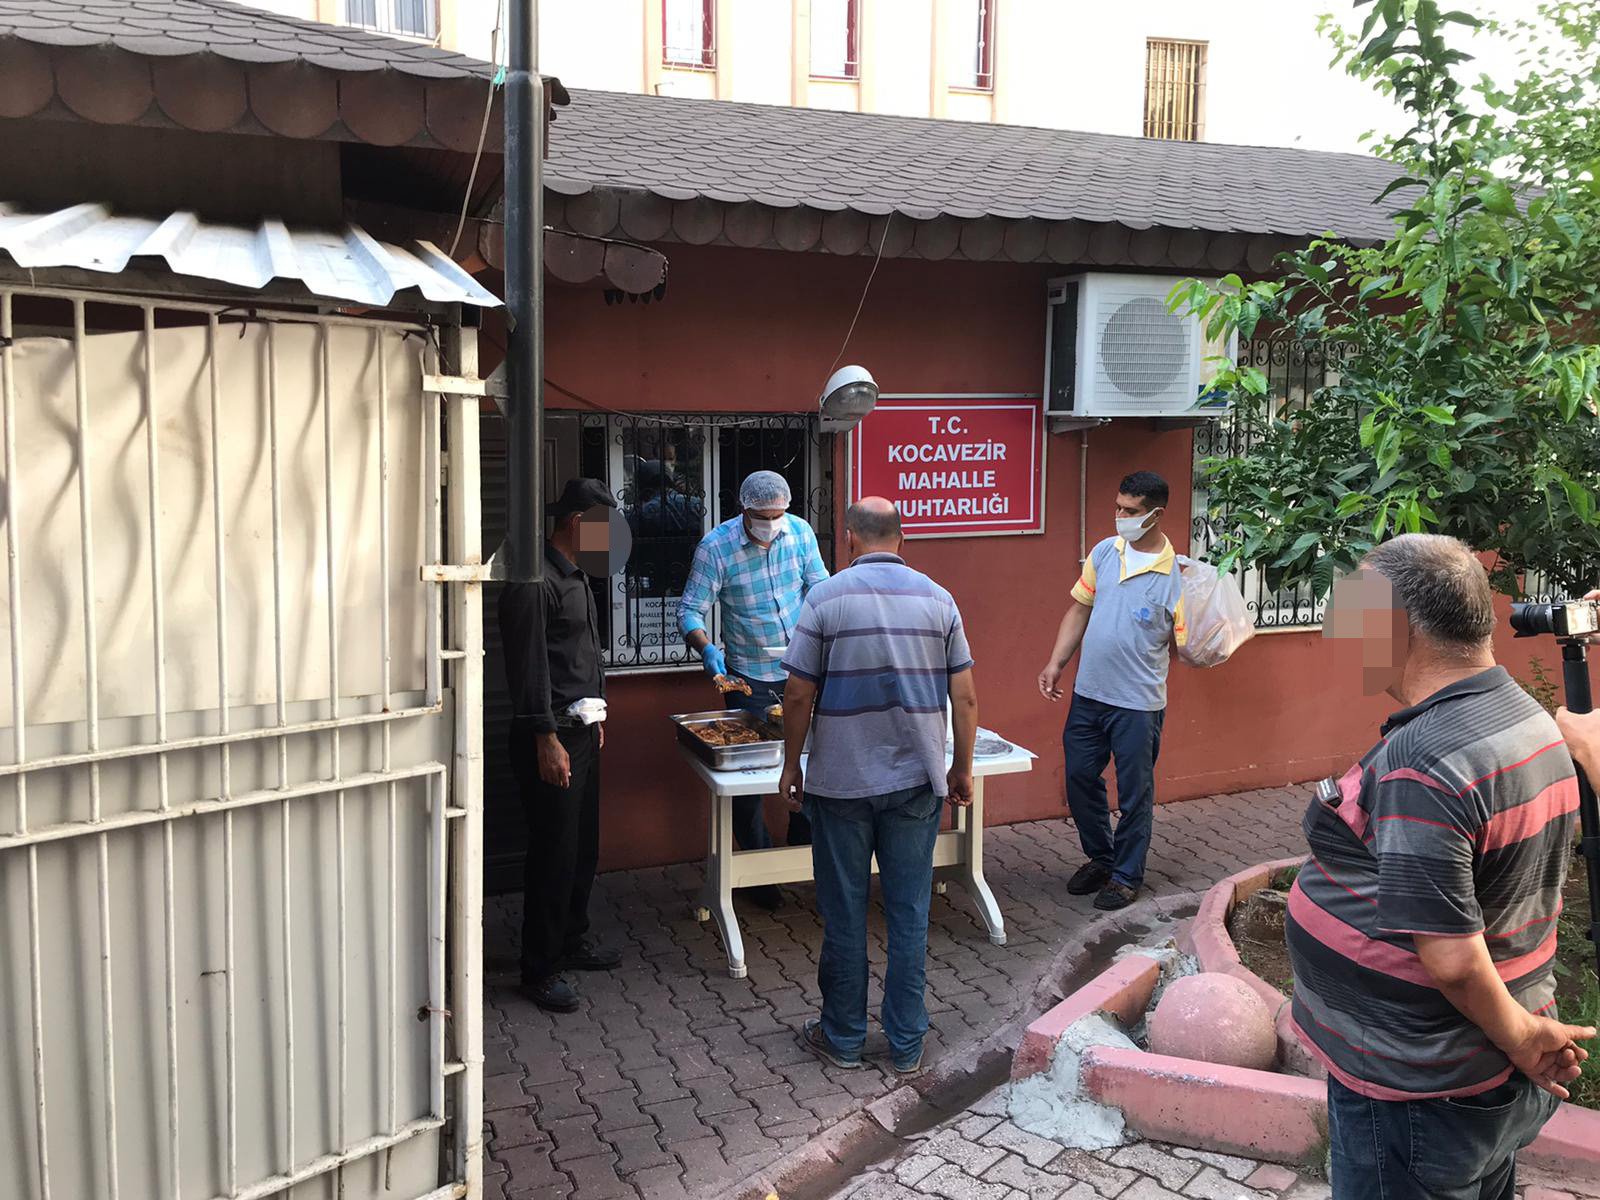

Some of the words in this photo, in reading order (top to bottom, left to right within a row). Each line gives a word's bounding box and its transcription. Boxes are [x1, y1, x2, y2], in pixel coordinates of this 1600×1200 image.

[928, 416, 968, 434] T.C.
[888, 439, 1006, 463] KOCAVEZİR
[898, 470, 996, 489] MAHALLE
